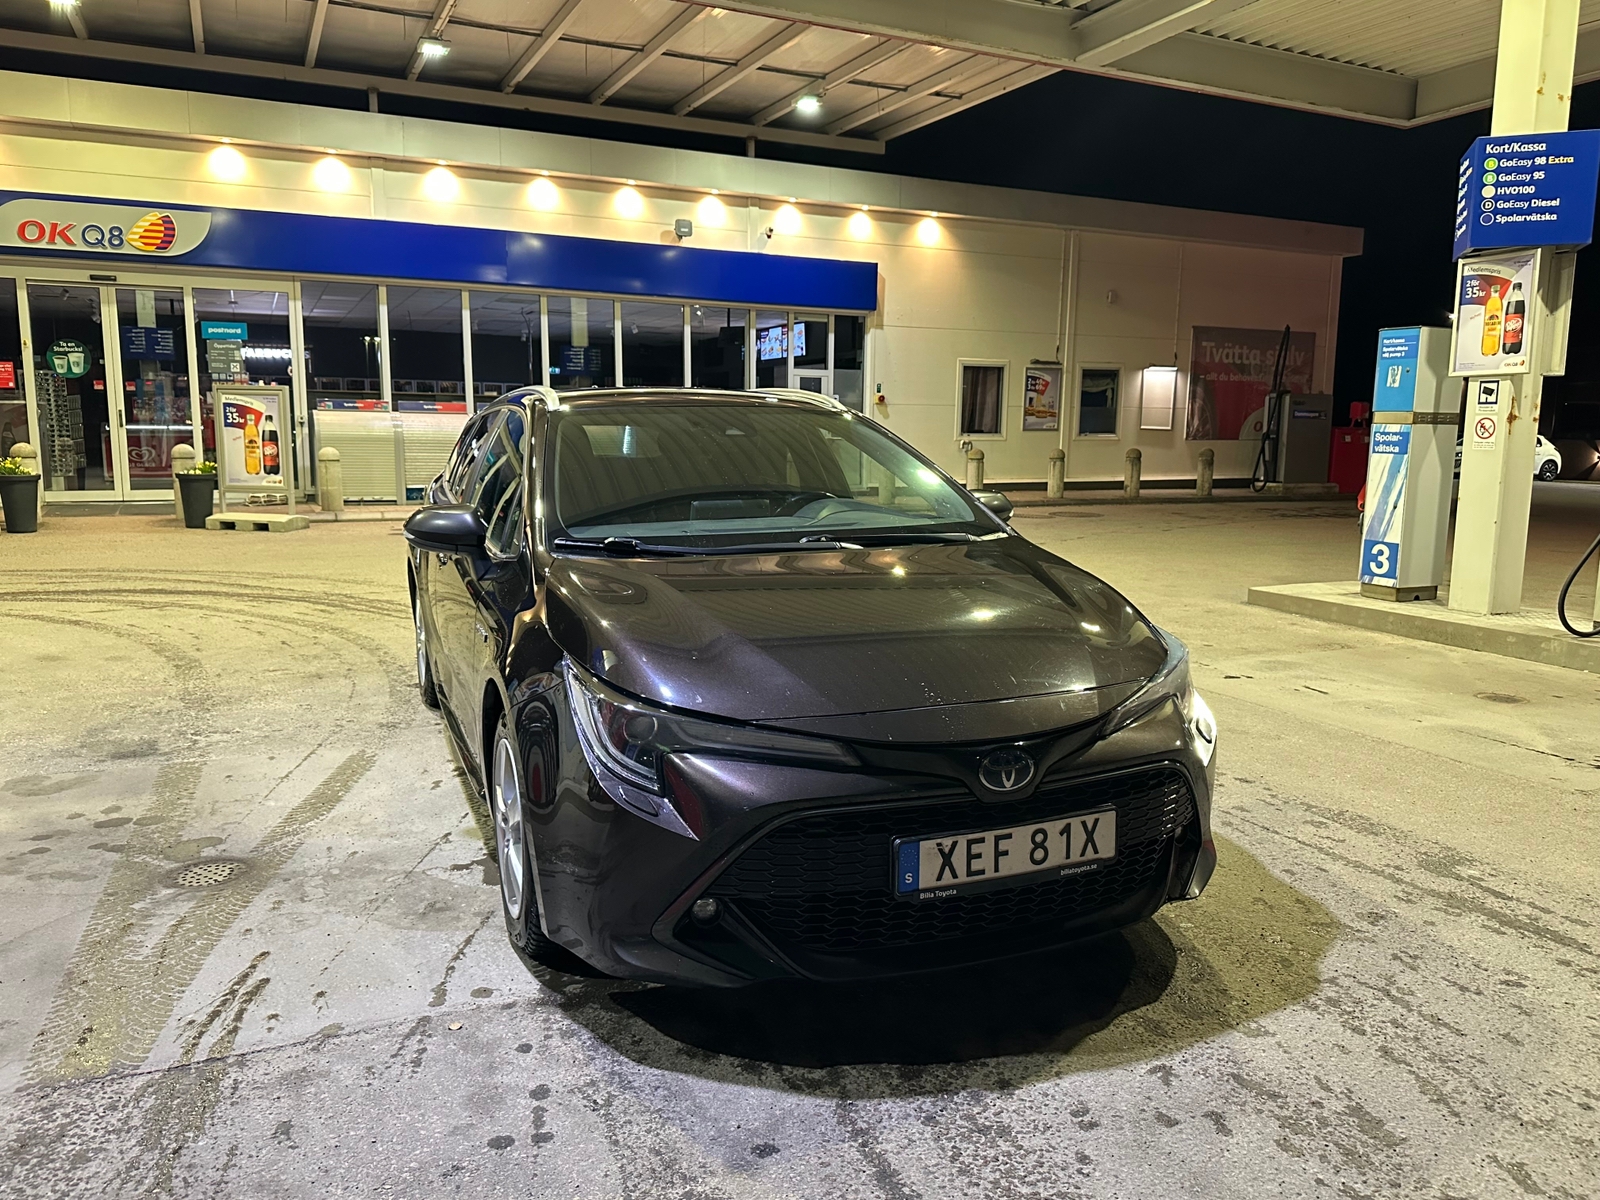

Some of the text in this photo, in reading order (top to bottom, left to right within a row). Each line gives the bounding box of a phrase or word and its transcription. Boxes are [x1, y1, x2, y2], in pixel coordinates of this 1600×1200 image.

[1486, 142, 1547, 154] Kort/Kassa
[1500, 159, 1533, 168] GoEasy
[1534, 157, 1546, 165] 98
[1548, 156, 1574, 164] Extra
[1498, 173, 1531, 182] GoEasy
[1533, 171, 1545, 179] 95
[1497, 186, 1535, 195] HVO100
[1497, 200, 1529, 210] GoEasy
[1531, 198, 1560, 207] Diesel
[1495, 212, 1557, 224] Spolarvätska
[17, 219, 125, 249] OK Q8
[1466, 266, 1501, 275] Medlemspris
[1202, 342, 1305, 366] Tvätta sjlv
[1206, 372, 1218, 380] allt
[1219, 372, 1228, 380] du
[1374, 432, 1403, 442] Spolar-
[1374, 444, 1399, 453] vätska
[1369, 543, 1390, 575] 3
[904, 817, 1100, 884] S XEF 81X
[919, 888, 957, 899] Bilia Toyota
